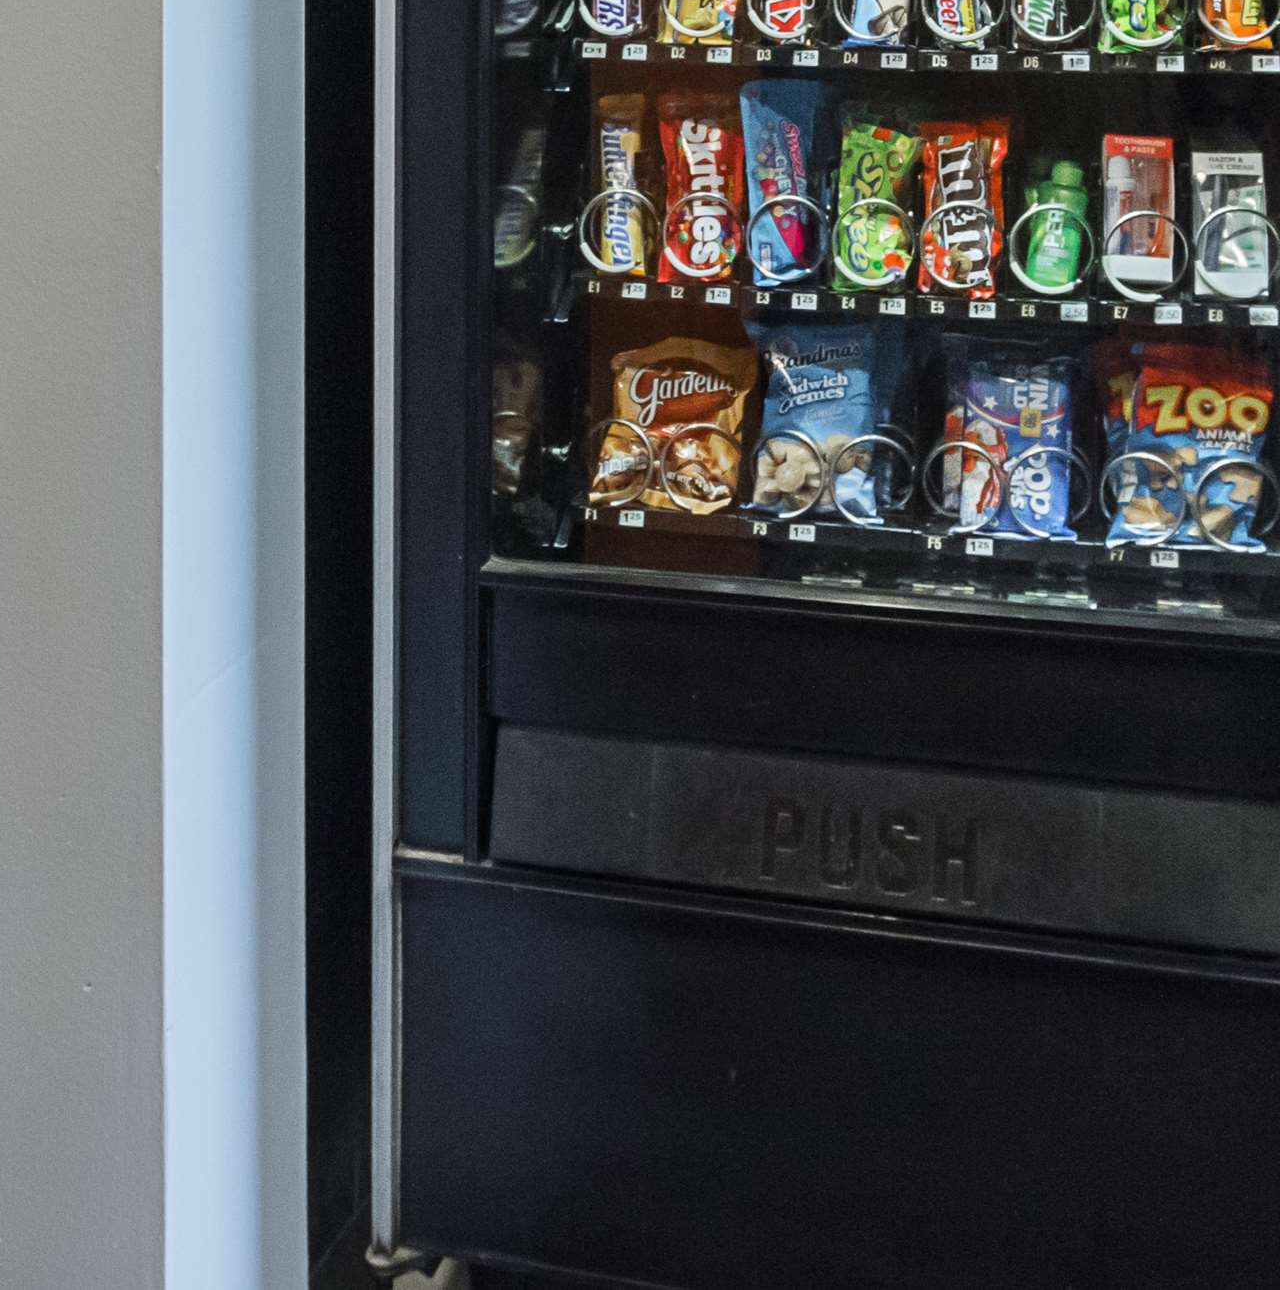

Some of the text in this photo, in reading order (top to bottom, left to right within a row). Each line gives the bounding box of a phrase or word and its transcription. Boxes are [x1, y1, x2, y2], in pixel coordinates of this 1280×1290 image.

[681, 119, 723, 264] Skittles
[788, 373, 849, 395] ndwich
[1147, 385, 1269, 433] ZOO
[1196, 429, 1254, 443] ANIMAL
[761, 805, 976, 905] PUSH
